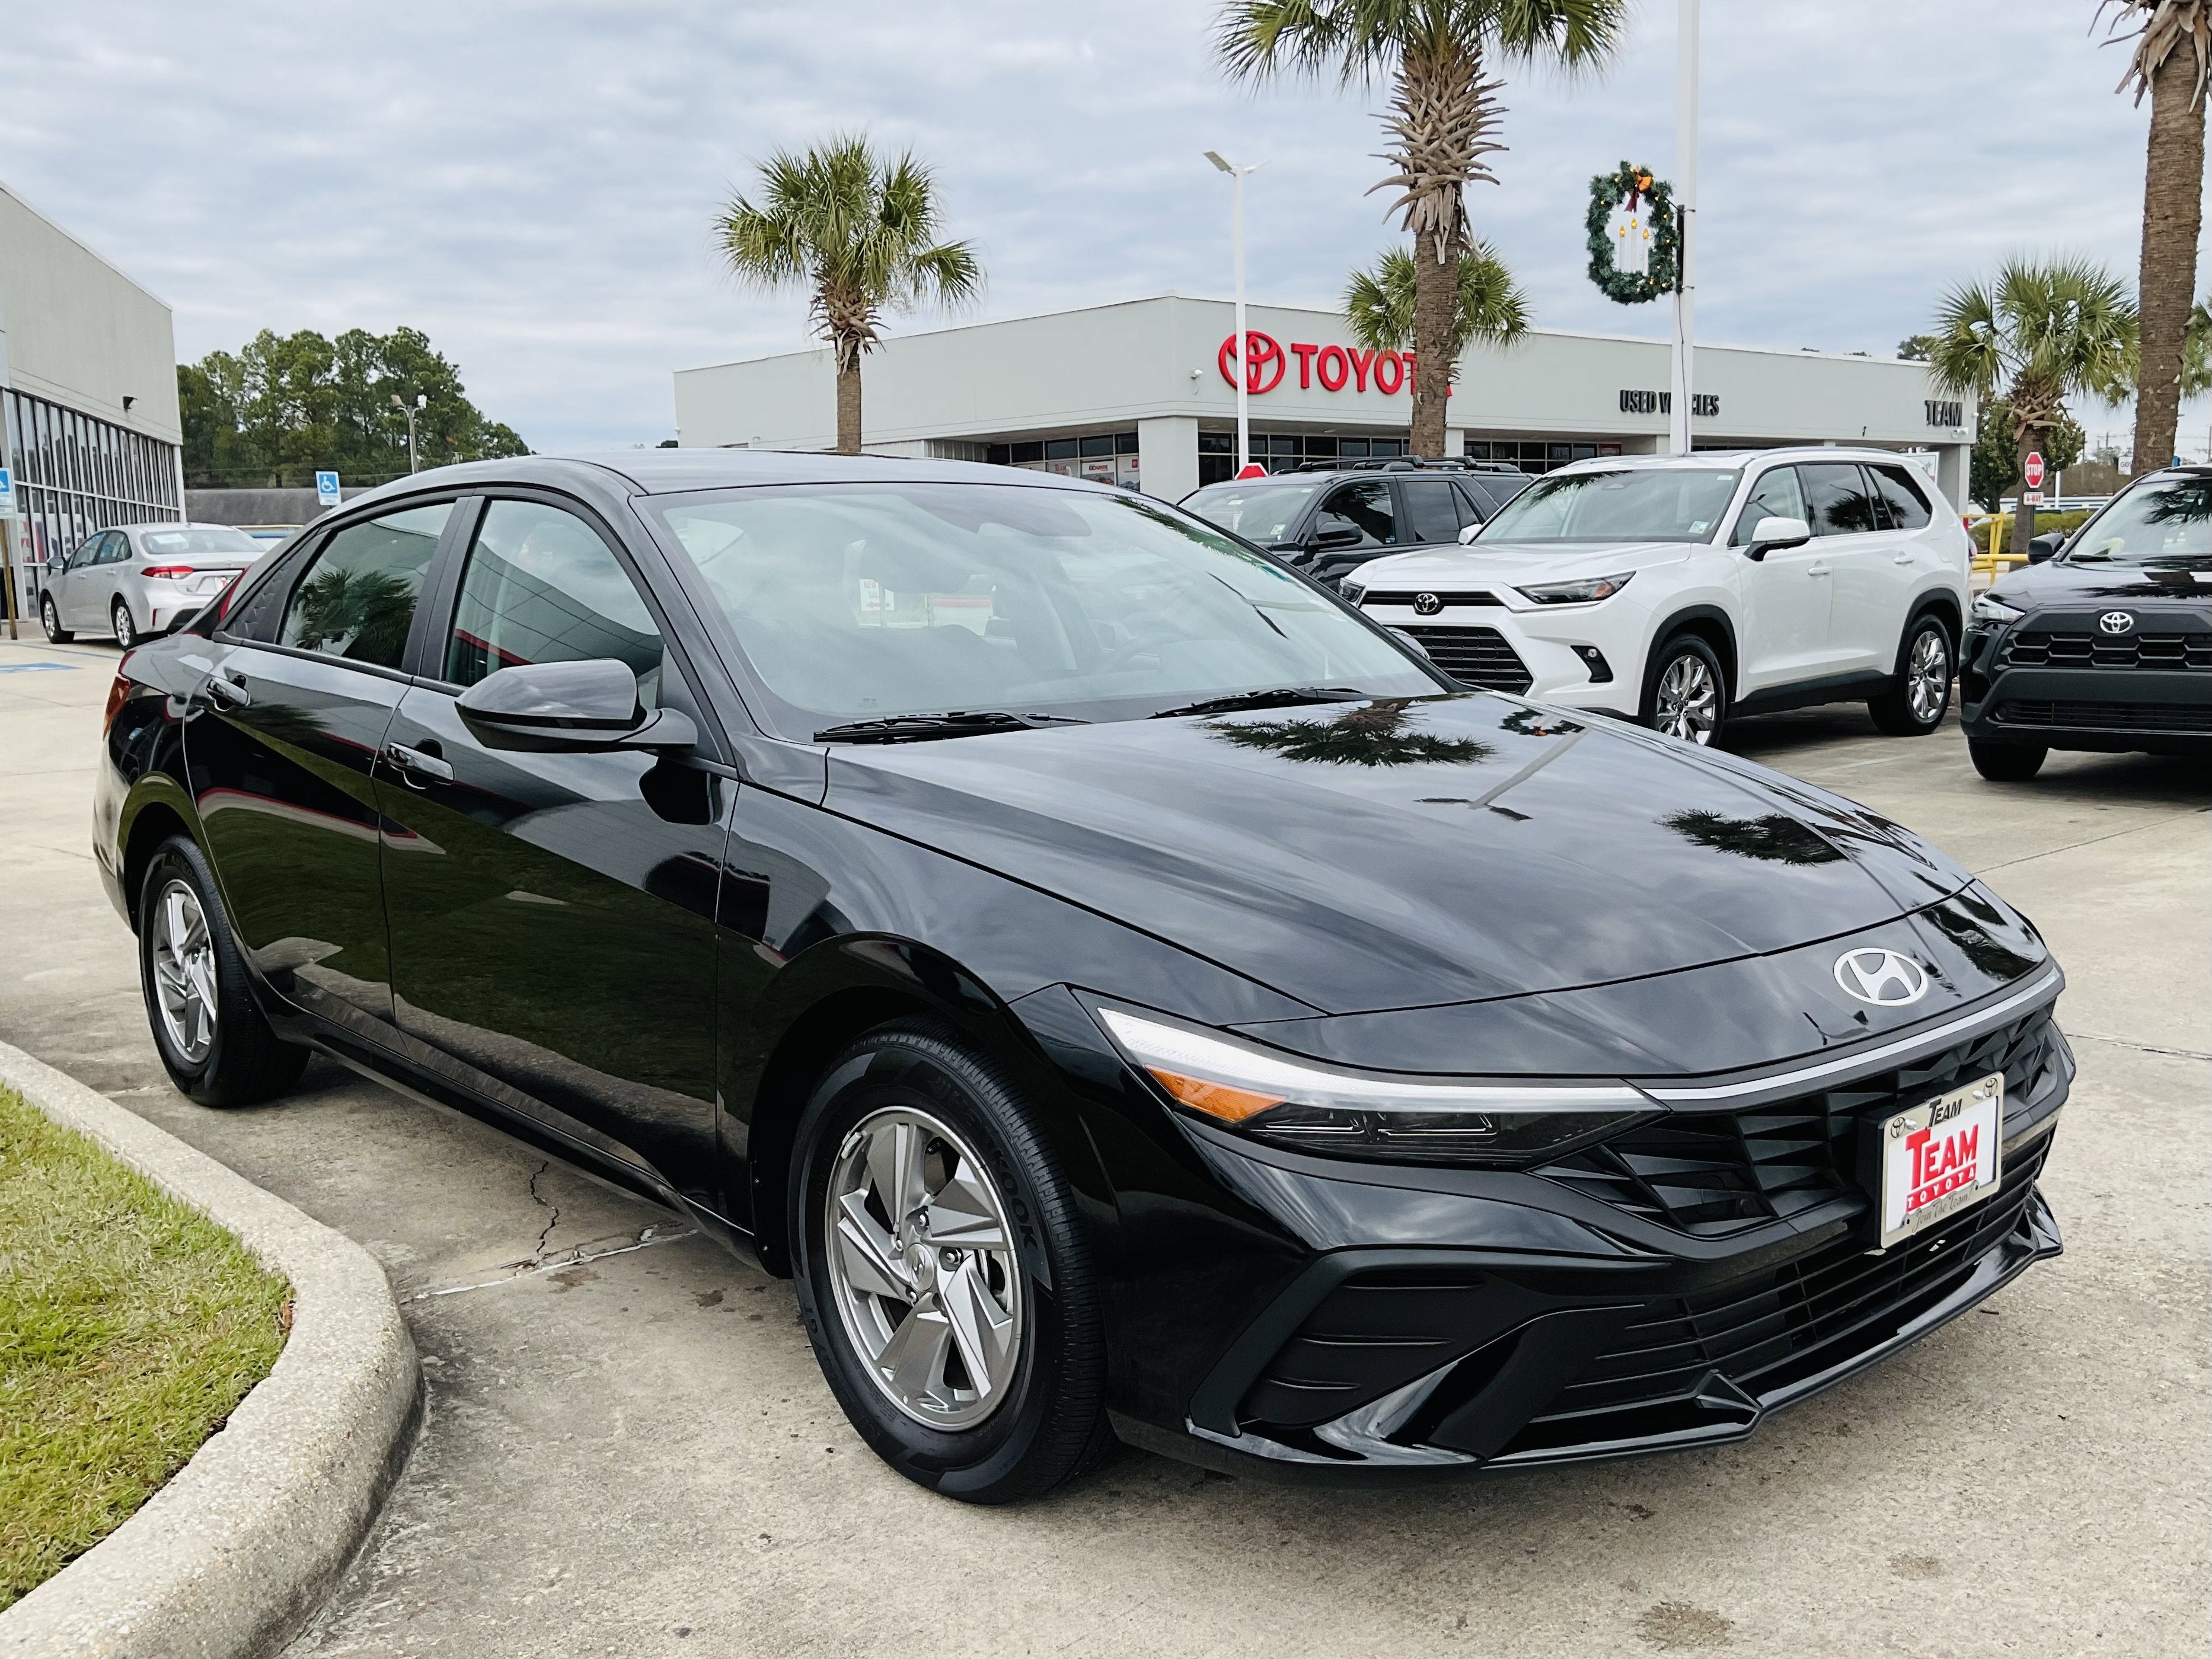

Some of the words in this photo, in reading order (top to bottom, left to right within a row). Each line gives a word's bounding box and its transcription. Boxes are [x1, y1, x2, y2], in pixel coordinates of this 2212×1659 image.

[1291, 343, 1452, 397] TOYOT
[1620, 390, 1656, 412] USED
[1659, 392, 1719, 415] VCLES
[1924, 400, 1962, 426] TEAM
[2026, 464, 2042, 476] STOP
[868, 591, 879, 599] SAL
[1927, 1098, 1962, 1128] TEAM
[1905, 1124, 1978, 1190] TEAM
[1907, 1167, 1974, 1208] TOYOTA
[1911, 1208, 1932, 1233] Join
[1933, 1200, 1946, 1217] The
